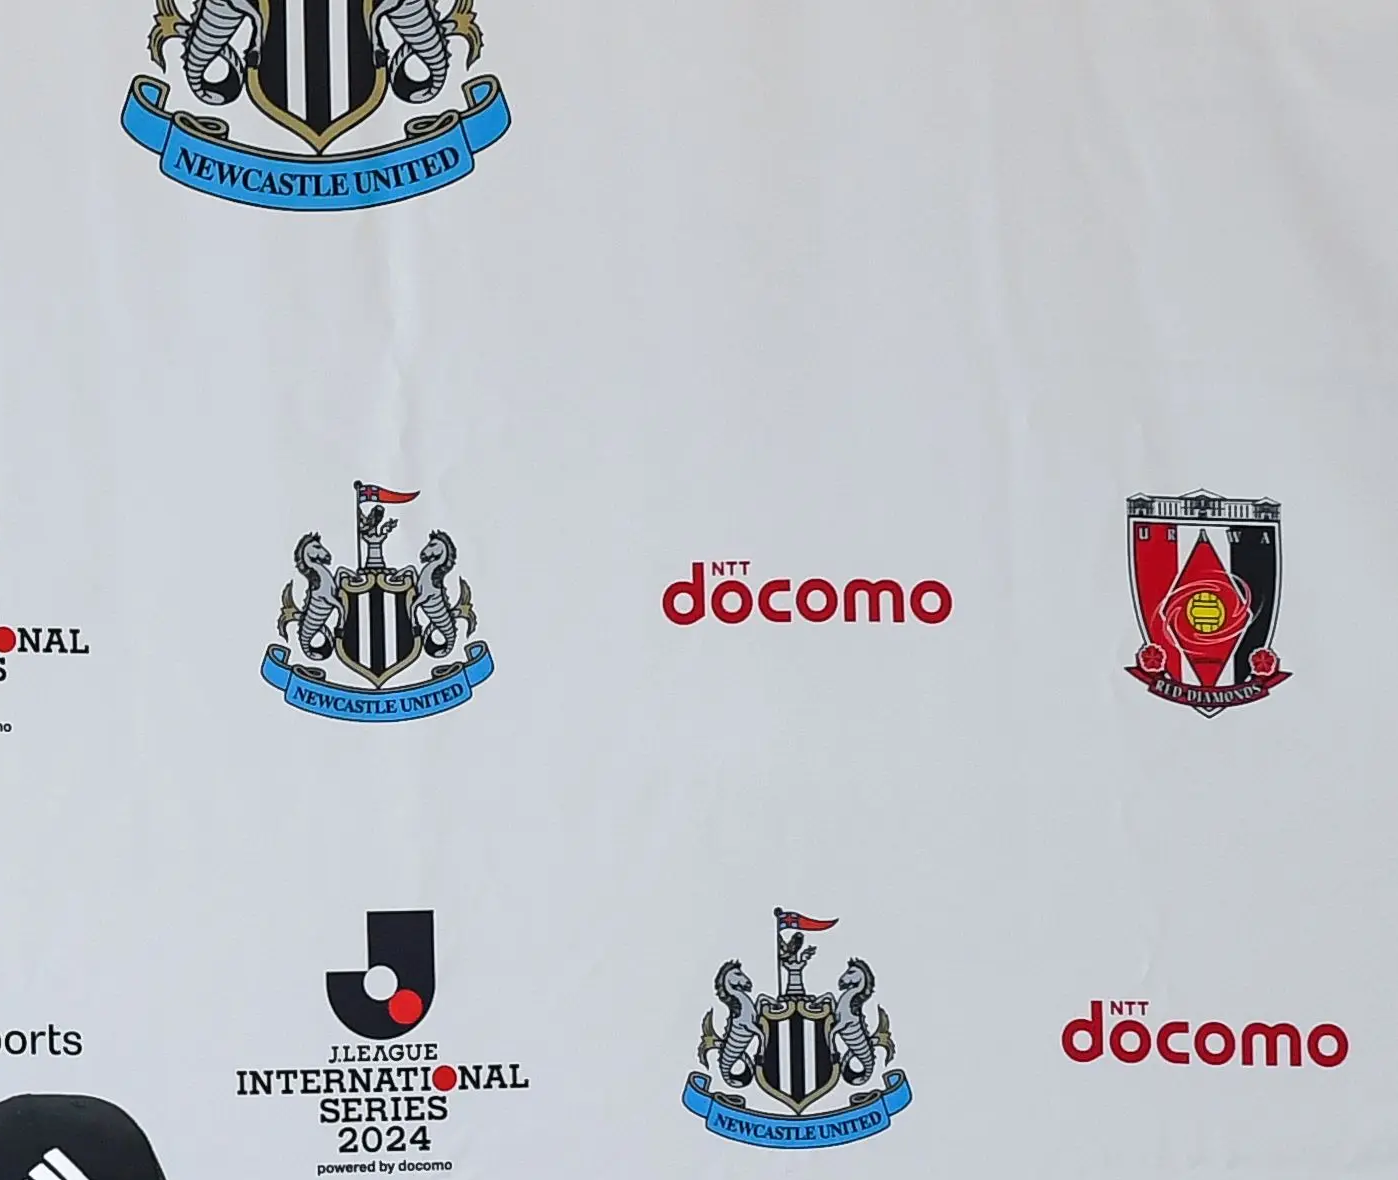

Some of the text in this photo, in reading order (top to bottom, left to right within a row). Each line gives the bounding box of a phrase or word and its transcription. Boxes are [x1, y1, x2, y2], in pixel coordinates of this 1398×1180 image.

[173, 146, 460, 197] NEWCASTLE UNITED
[711, 561, 751, 576] NTT
[662, 561, 953, 626] docomo
[293, 682, 464, 716] NEWCASTLE UNITED
[1154, 679, 1262, 704] RED DIAMONDS
[1110, 1001, 1149, 1016] NTT
[1061, 1000, 1349, 1067] docomo
[328, 1043, 438, 1064] J.LEAGUE
[319, 1096, 448, 1124] SERIES
[337, 1125, 431, 1153] 2024
[712, 1108, 883, 1142] NEWCASTLE UNITED
[317, 1158, 453, 1176] powered by docomo
